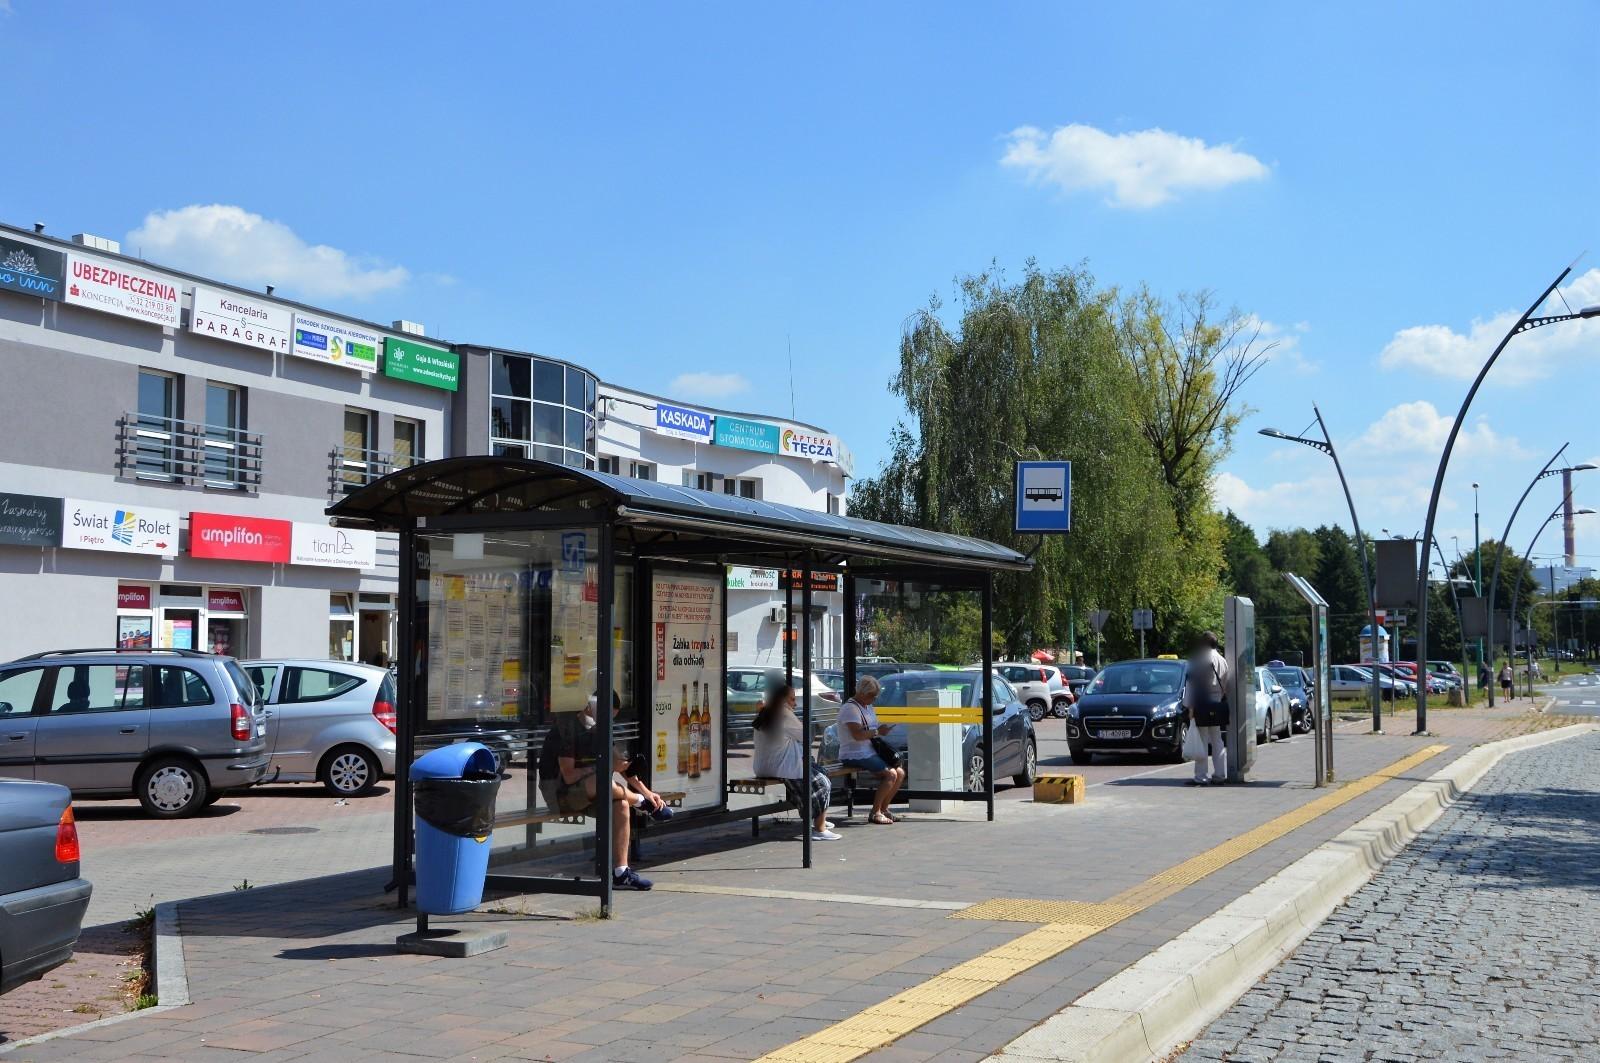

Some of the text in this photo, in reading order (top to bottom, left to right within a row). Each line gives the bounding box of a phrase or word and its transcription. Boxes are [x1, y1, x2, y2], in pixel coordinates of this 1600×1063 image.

[73, 261, 177, 303] UBEZPIECZENIA
[81, 289, 125, 309] KONCEPCJA
[136, 296, 144, 307] 32
[145, 299, 156, 310] 219
[157, 301, 165, 312] 03
[125, 305, 177, 324] www.koncepcja.pl
[220, 299, 268, 321] Kancelaria
[196, 318, 288, 349] PARAGRAF
[347, 343, 353, 354] L
[660, 409, 707, 432] KASKADA
[730, 422, 766, 436] CENTRUM
[720, 435, 774, 450] STOMATOLOGII
[792, 434, 832, 447] APTEKA
[792, 442, 833, 457] TĘCZA
[73, 508, 171, 535] Świat Rolet
[83, 535, 105, 545] Piętro
[201, 526, 262, 547] amplifon
[312, 530, 354, 554] tianDe
[210, 596, 238, 606] amplifon
[673, 654, 682, 666] dla
